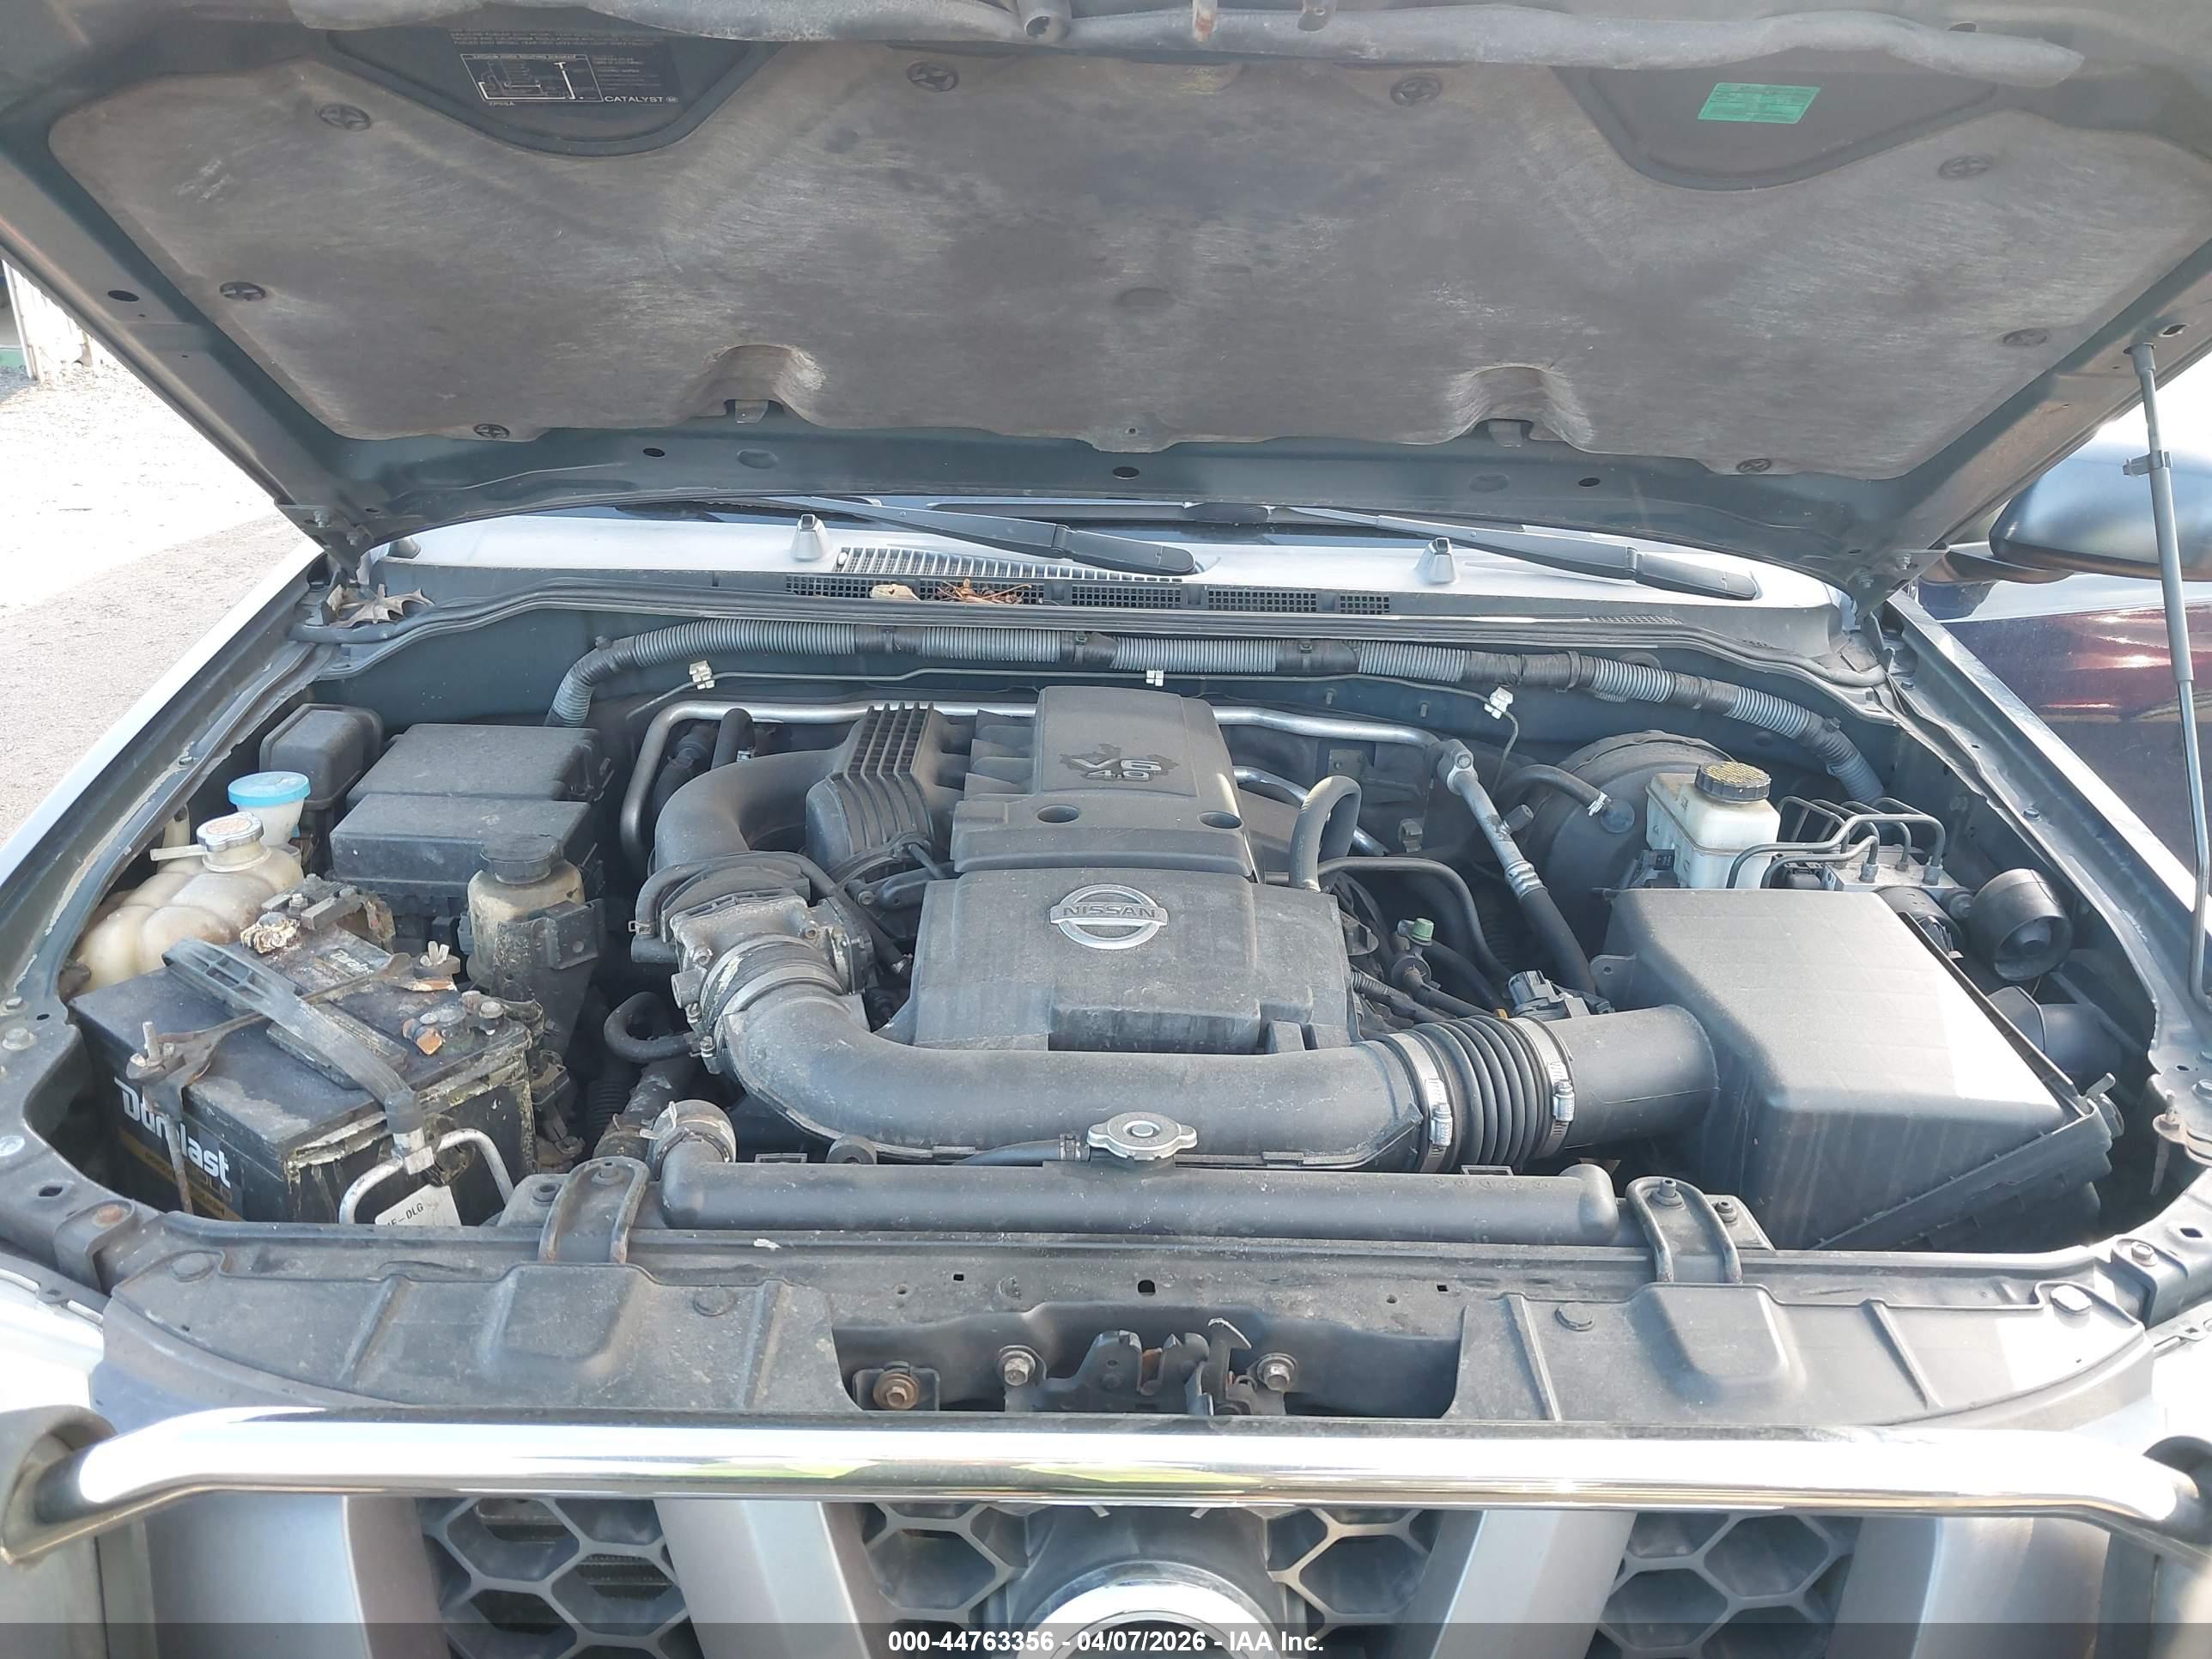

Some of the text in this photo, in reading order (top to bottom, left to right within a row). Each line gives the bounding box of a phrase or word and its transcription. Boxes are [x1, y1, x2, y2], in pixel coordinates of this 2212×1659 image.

[1070, 757, 1162, 772] V6
[1085, 769, 1151, 781] 4.0
[1063, 904, 1155, 919] NISSAN
